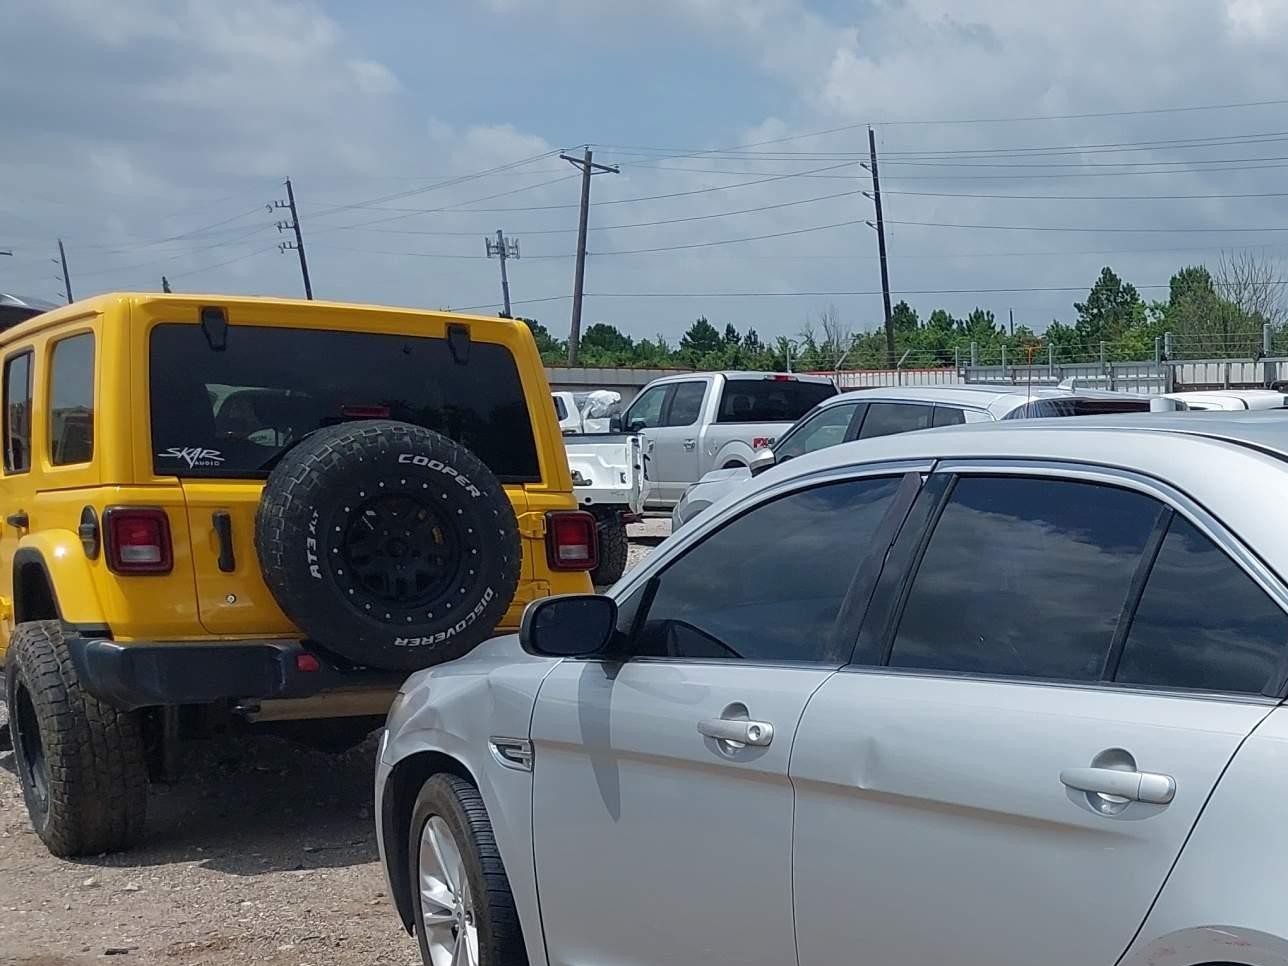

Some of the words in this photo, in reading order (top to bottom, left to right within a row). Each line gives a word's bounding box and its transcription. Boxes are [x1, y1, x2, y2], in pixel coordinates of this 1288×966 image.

[157, 447, 225, 470] SKAR
[398, 454, 481, 497] COOPER
[306, 536, 322, 579] AT3
[394, 586, 494, 647] DISCOVERER
